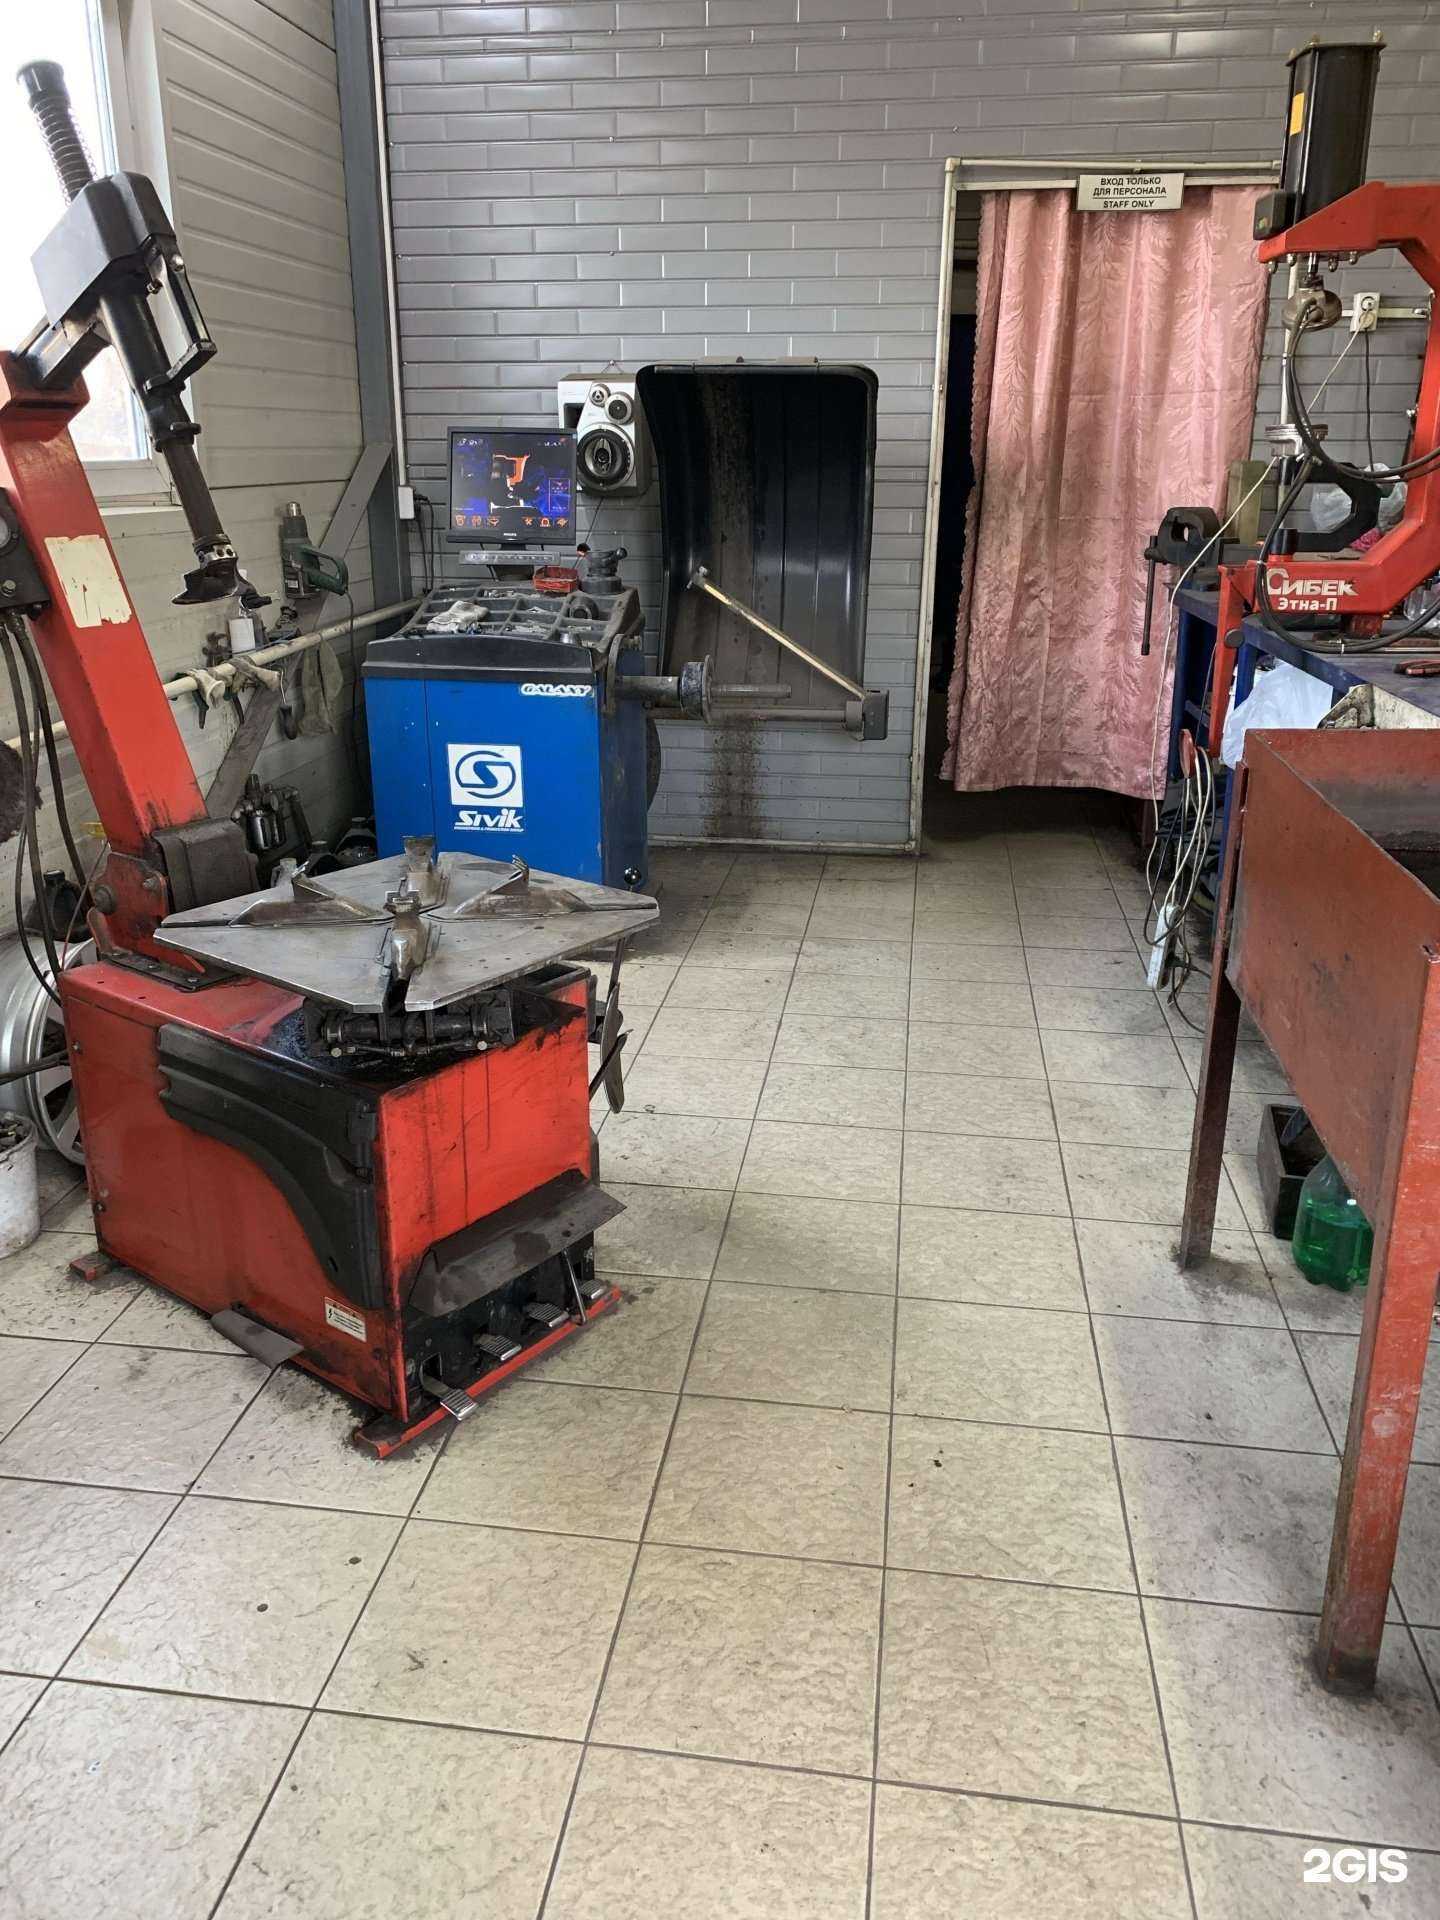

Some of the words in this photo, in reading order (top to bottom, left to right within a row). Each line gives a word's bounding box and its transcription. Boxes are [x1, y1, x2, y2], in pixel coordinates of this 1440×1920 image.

[1100, 177, 1124, 186] ВХОД
[1126, 176, 1162, 185] ТОЛЬКО
[1093, 188, 1111, 196] ДЛЯ
[1113, 187, 1167, 196] ПЕРСОНАЛА
[1103, 200, 1130, 208] STAFF
[1131, 200, 1155, 208] ONLY
[1277, 597, 1338, 611] Этна-П
[520, 683, 592, 697] GALAXY
